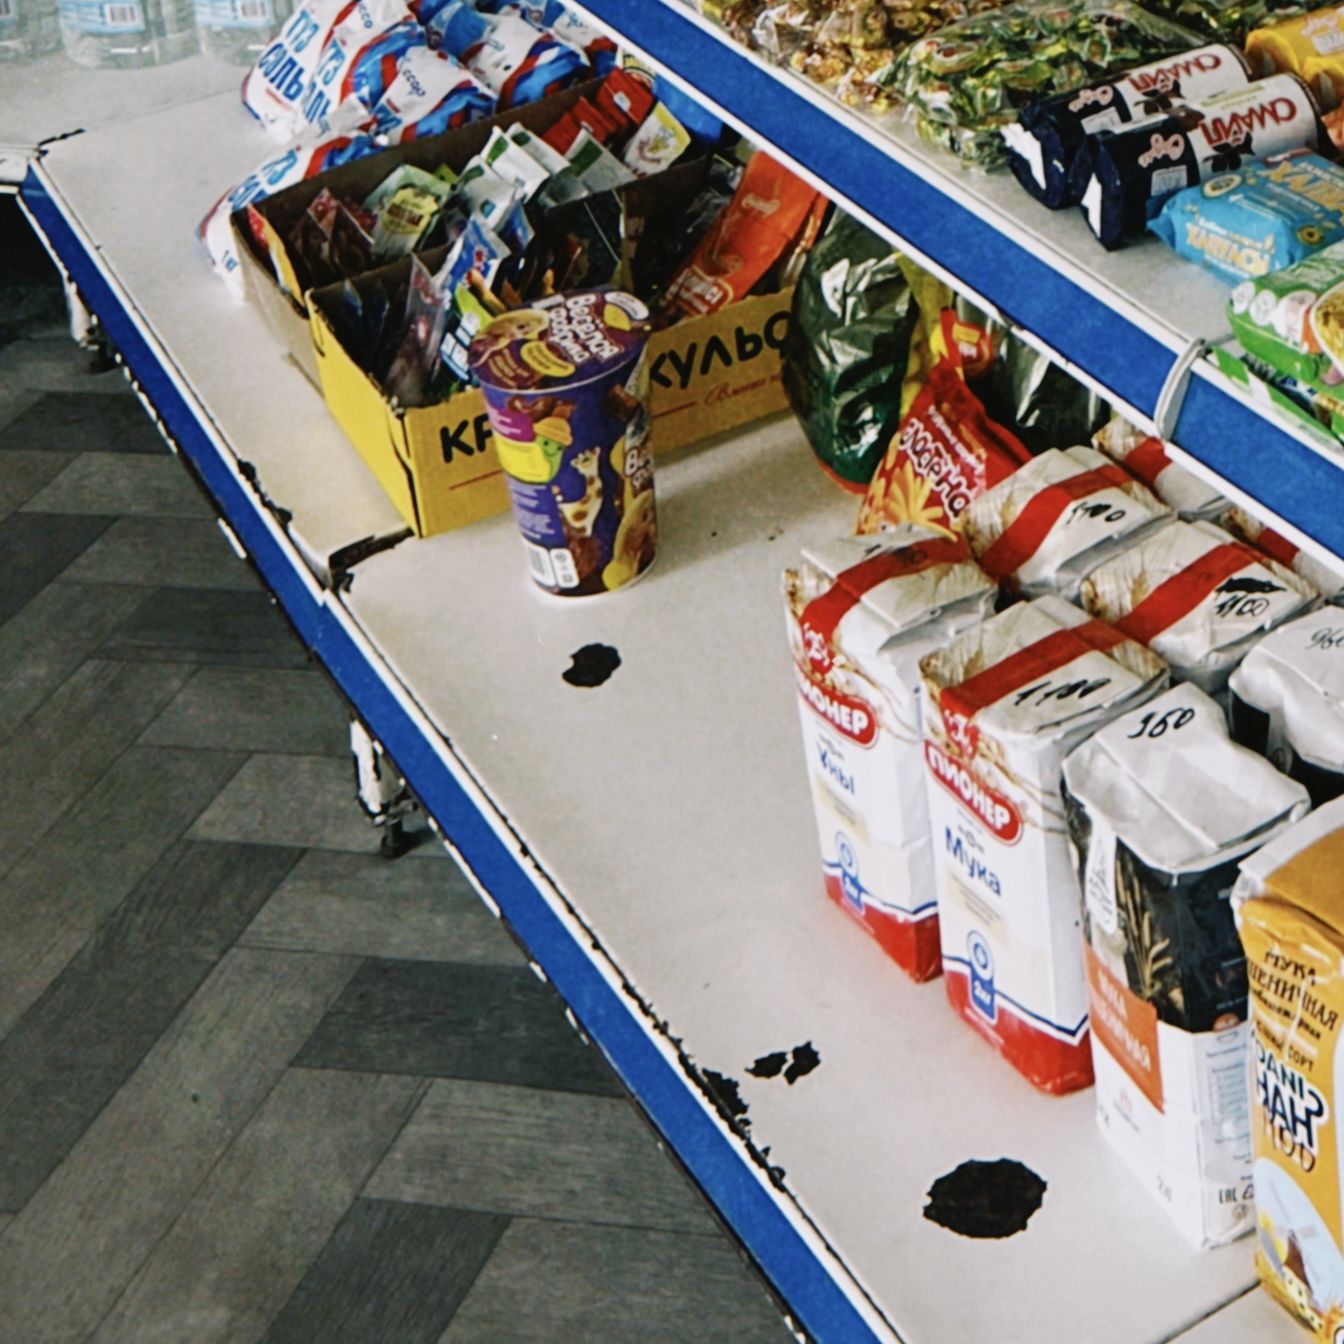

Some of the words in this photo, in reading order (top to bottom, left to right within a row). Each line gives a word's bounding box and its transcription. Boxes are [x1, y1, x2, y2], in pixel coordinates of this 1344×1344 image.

[257, 41, 304, 102] СОЛЬ
[1128, 52, 1222, 93] СМАЙЛ
[1199, 96, 1298, 147] СМАЙЛ
[927, 749, 1013, 830] ПИОНЕР
[945, 828, 1003, 898] Мука
[1250, 961, 1339, 1033] ШЕНИЧНАЯ
